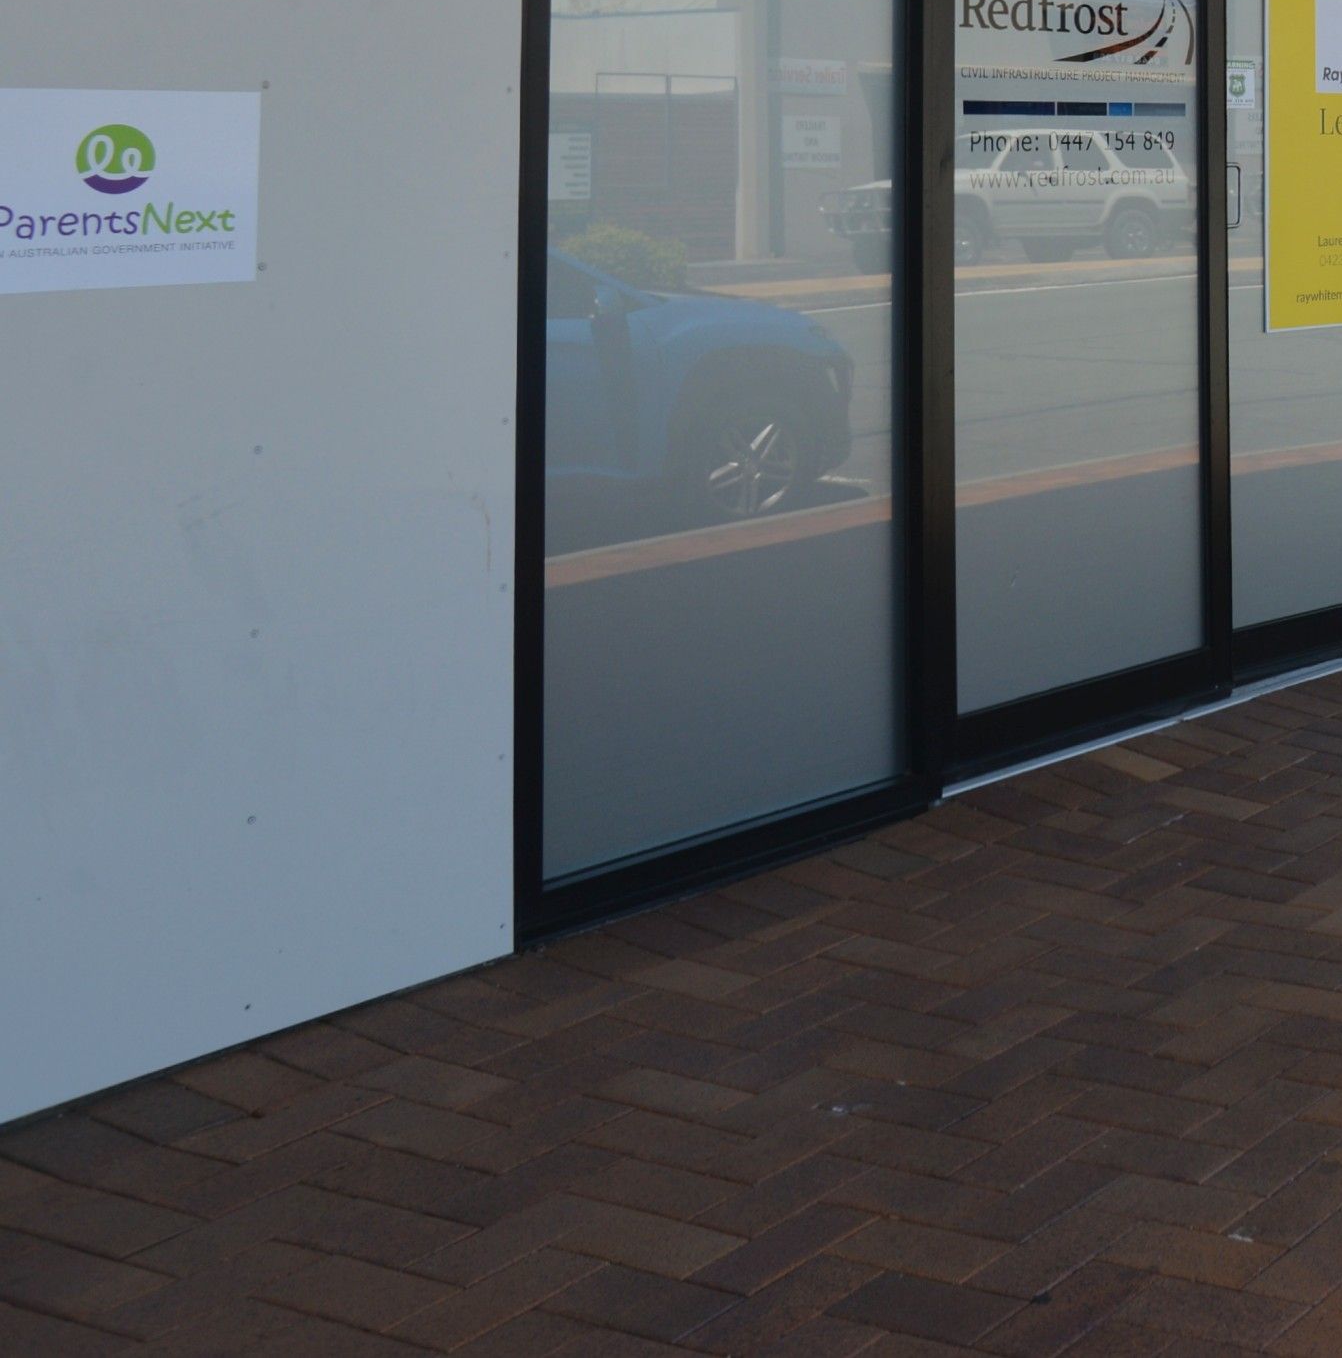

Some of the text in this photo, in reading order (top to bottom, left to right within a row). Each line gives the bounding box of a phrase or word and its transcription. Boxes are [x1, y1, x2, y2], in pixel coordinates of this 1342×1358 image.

[960, 66, 1186, 84] CIVIL INFRASTRUCTURE PROJECT MANAGEMENT
[970, 130, 1175, 153] Phone: 0447 154 849
[970, 166, 1175, 190] www.redfrost.com.au
[8, 246, 88, 259] AUSTRALIAN
[92, 243, 175, 255] GOVERNMENT
[180, 240, 236, 251] INITIATIVE
